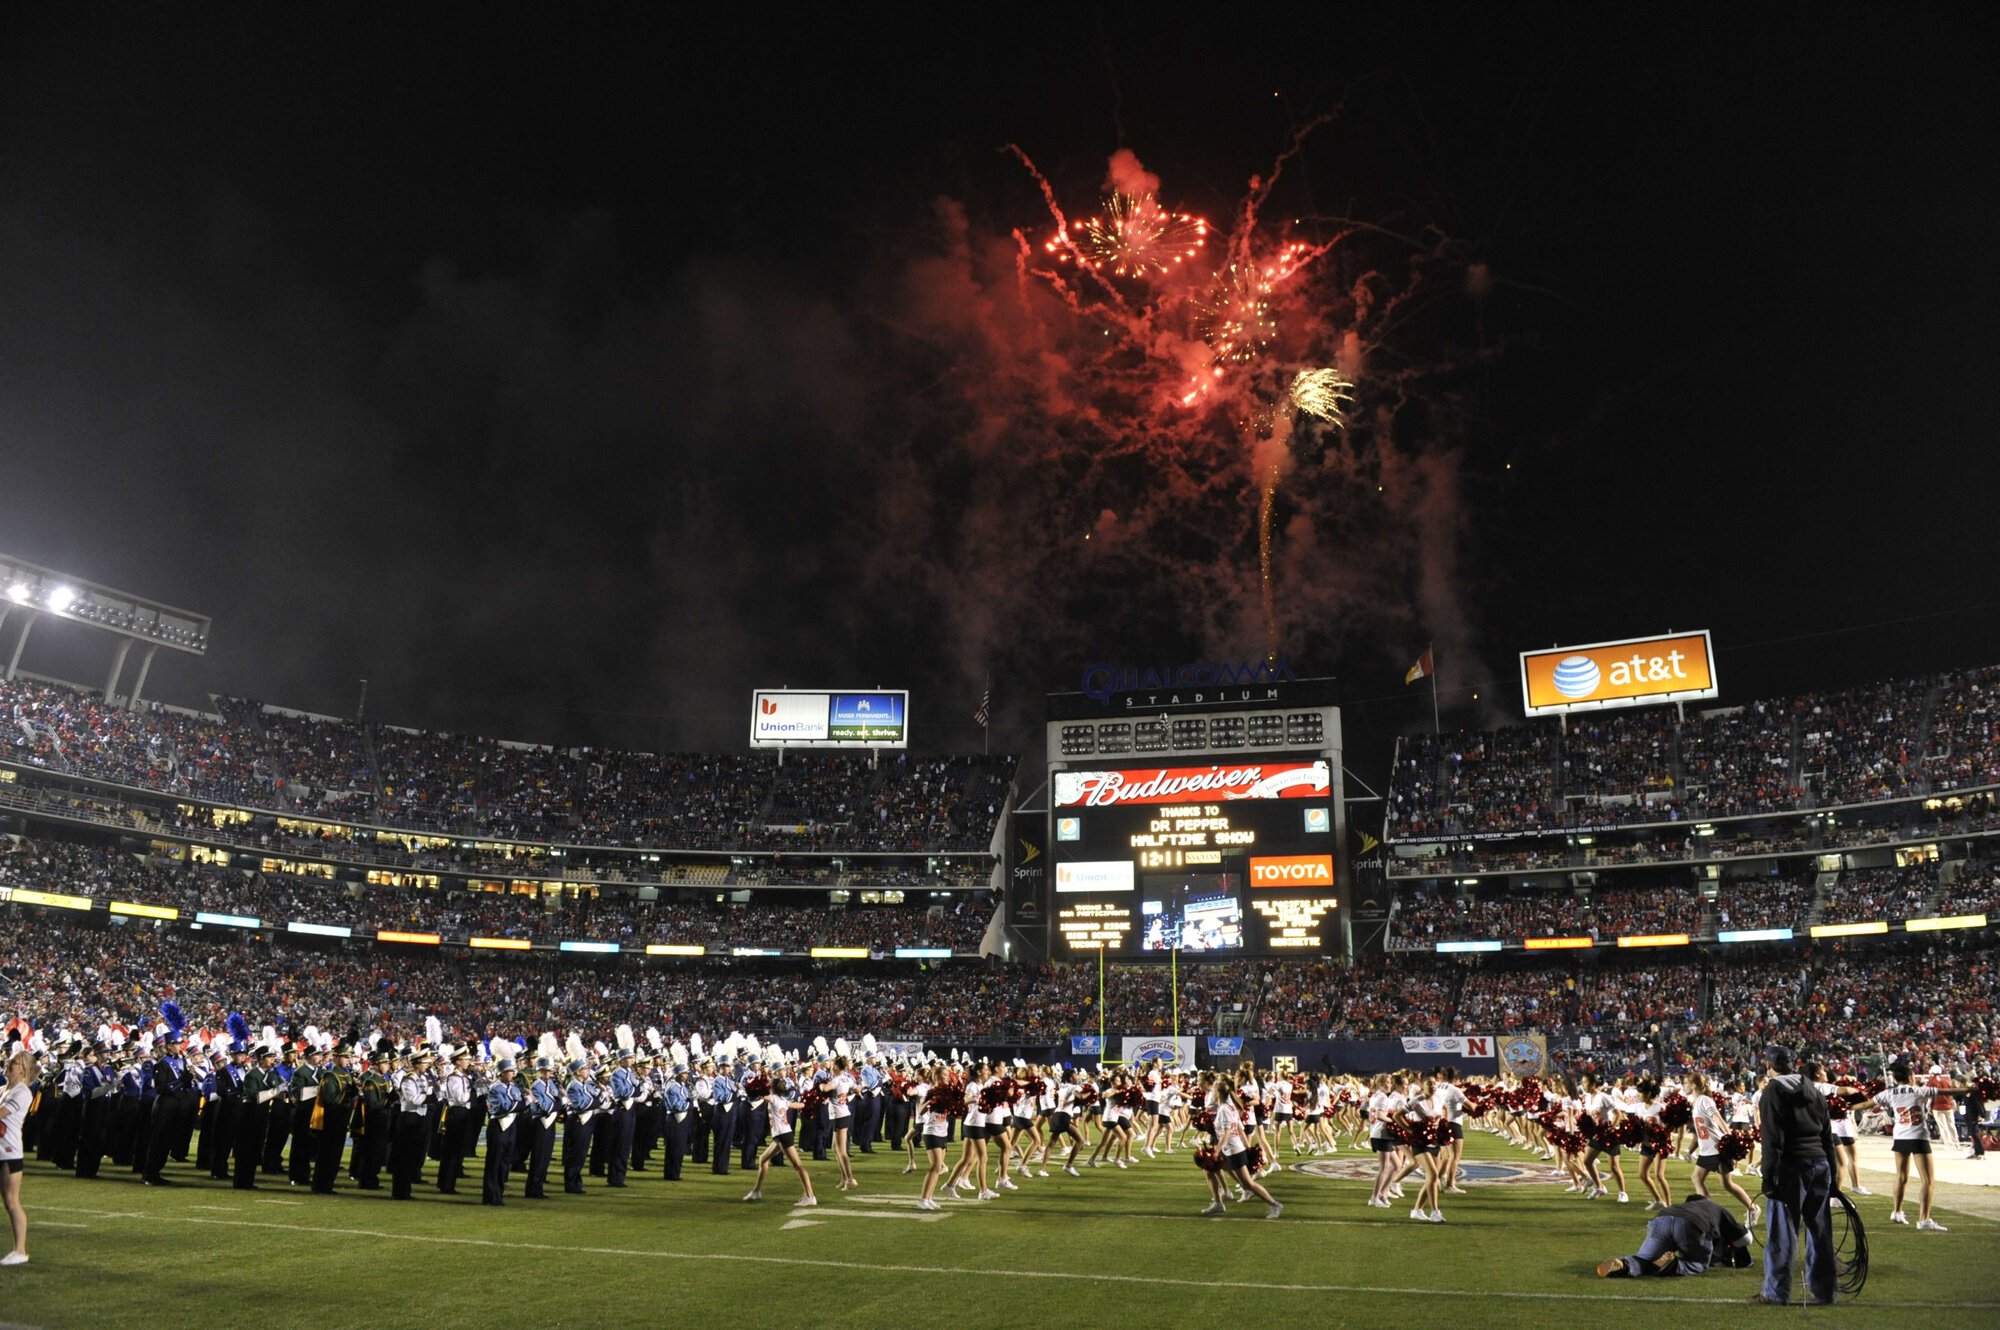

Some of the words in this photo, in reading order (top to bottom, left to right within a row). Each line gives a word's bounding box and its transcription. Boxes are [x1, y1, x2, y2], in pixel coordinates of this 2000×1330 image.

[1609, 650, 1687, 686] at&t
[1126, 689, 1278, 707] STADIUM
[1081, 765, 1261, 806] Budweiser
[1160, 807, 1201, 818] THANKS
[1204, 806, 1219, 816] TO
[1150, 820, 1170, 832] DR
[1176, 818, 1229, 831] PEPPER
[1131, 833, 1206, 847] HALFTIME
[1215, 831, 1254, 845] SHOW
[1254, 863, 1329, 881] TOYOTA
[1351, 858, 1384, 870] Sprint
[1014, 867, 1043, 879] Sprint
[1139, 1042, 1163, 1052] PACIFIC
[1467, 1038, 1488, 1056] N
[1276, 1056, 1295, 1073] 25
